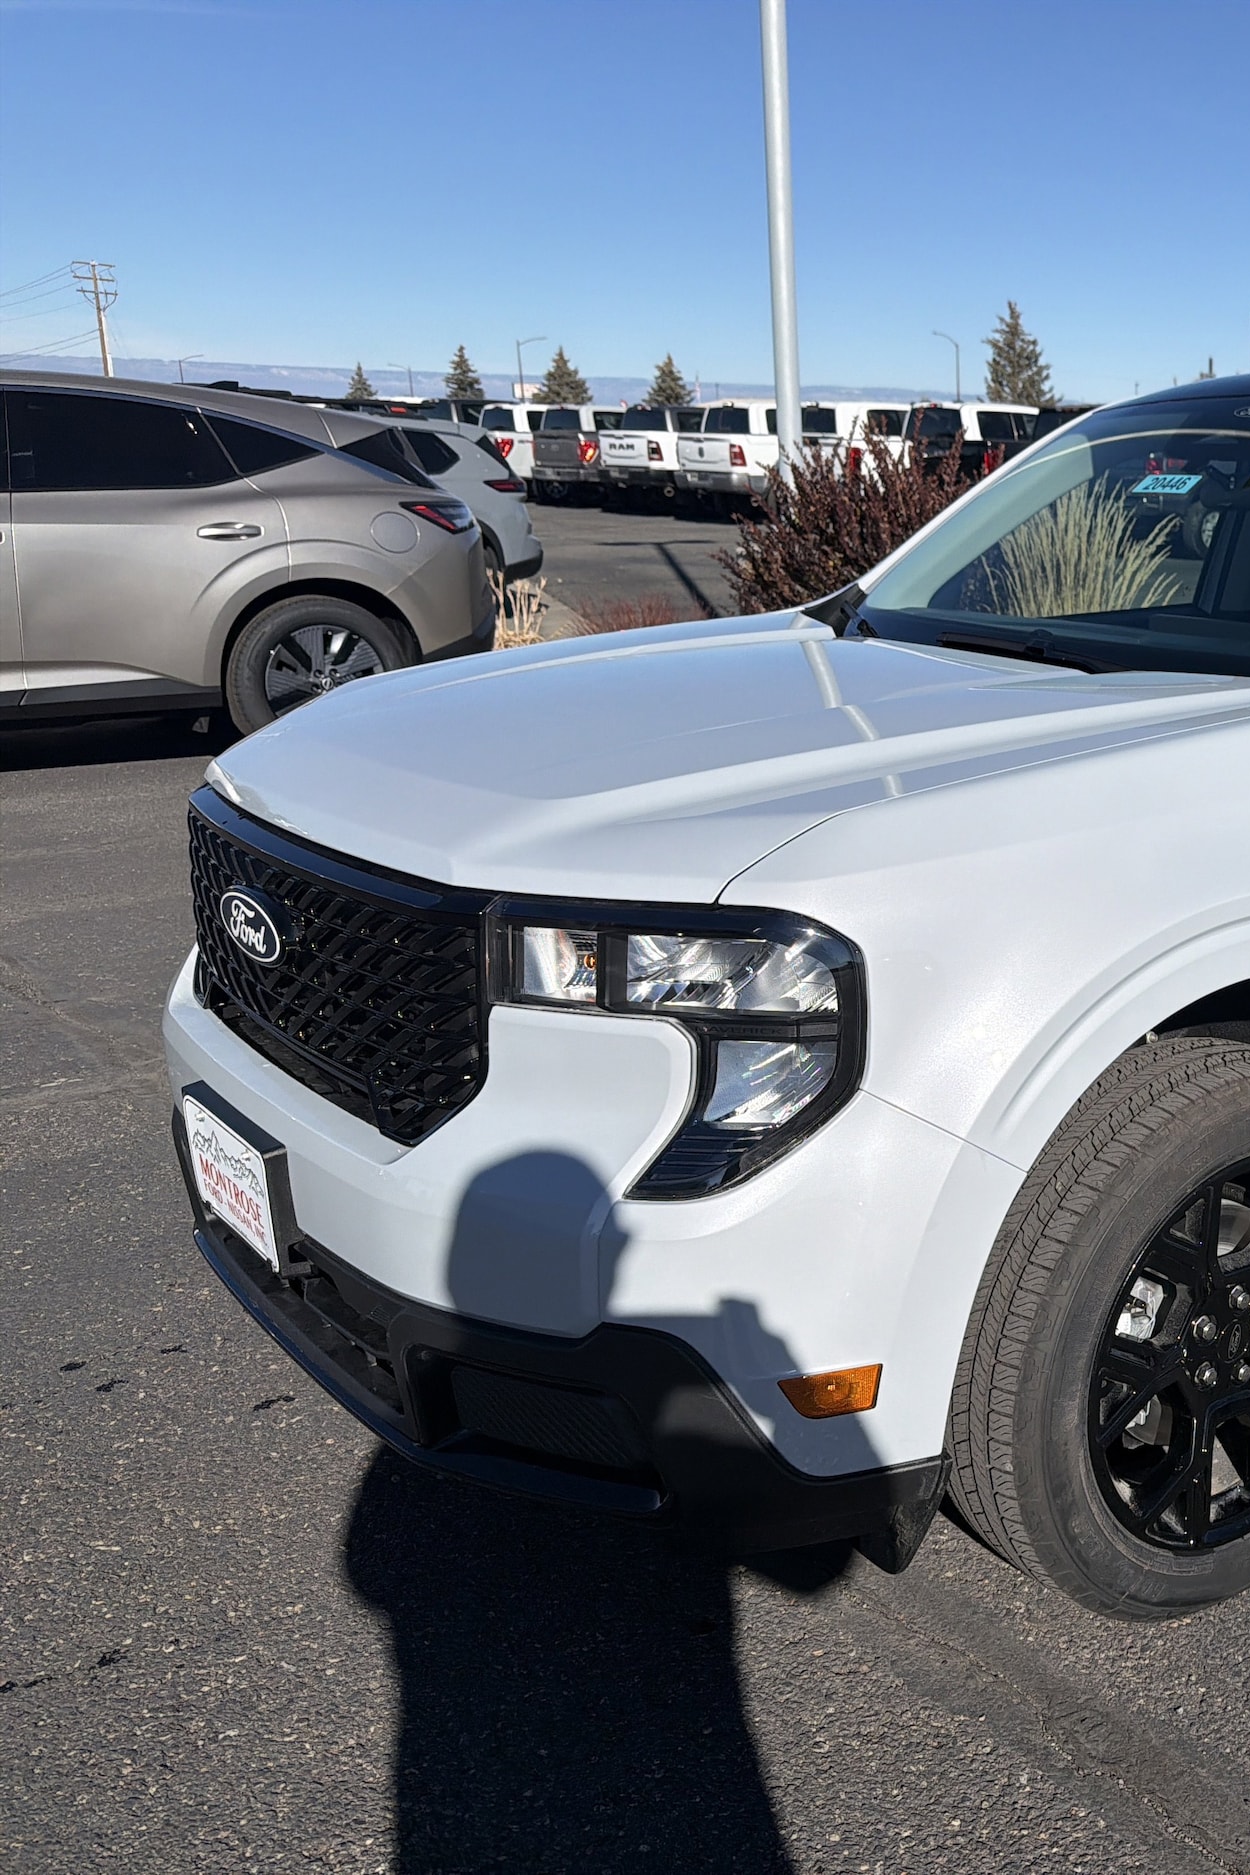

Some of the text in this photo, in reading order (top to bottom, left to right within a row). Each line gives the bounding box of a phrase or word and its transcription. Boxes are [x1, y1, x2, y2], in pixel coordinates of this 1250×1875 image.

[608, 443, 635, 451] RAM
[1142, 477, 1191, 490] 20446
[230, 899, 267, 954] Ford
[199, 1153, 264, 1229] MONTROSE
[204, 1178, 223, 1204] FORD
